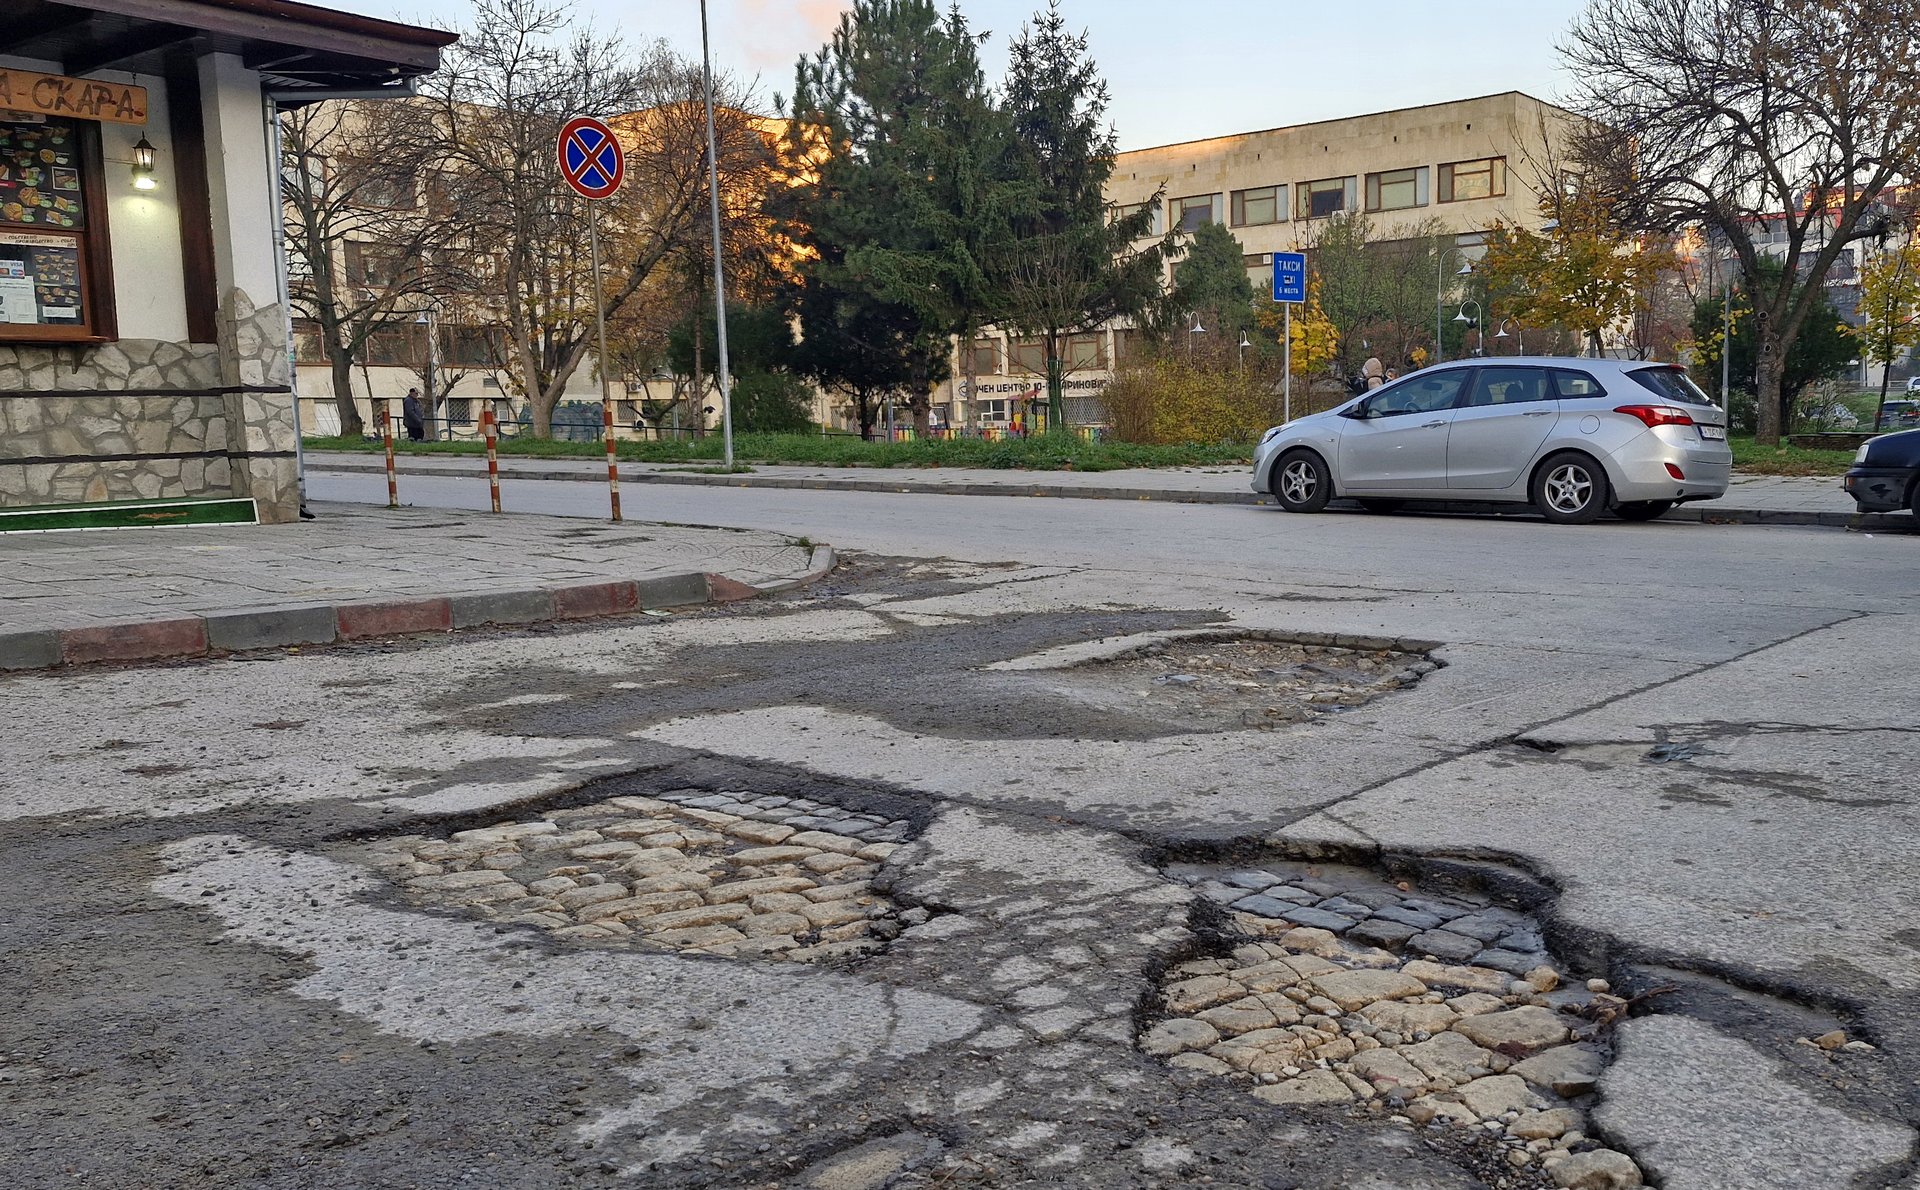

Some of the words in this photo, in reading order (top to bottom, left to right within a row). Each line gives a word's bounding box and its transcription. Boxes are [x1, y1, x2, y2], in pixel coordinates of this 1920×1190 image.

[32, 77, 134, 119] СКАРА
[1278, 260, 1301, 272] ТАКСИ
[996, 382, 1031, 393] ЦЕНТЪР
